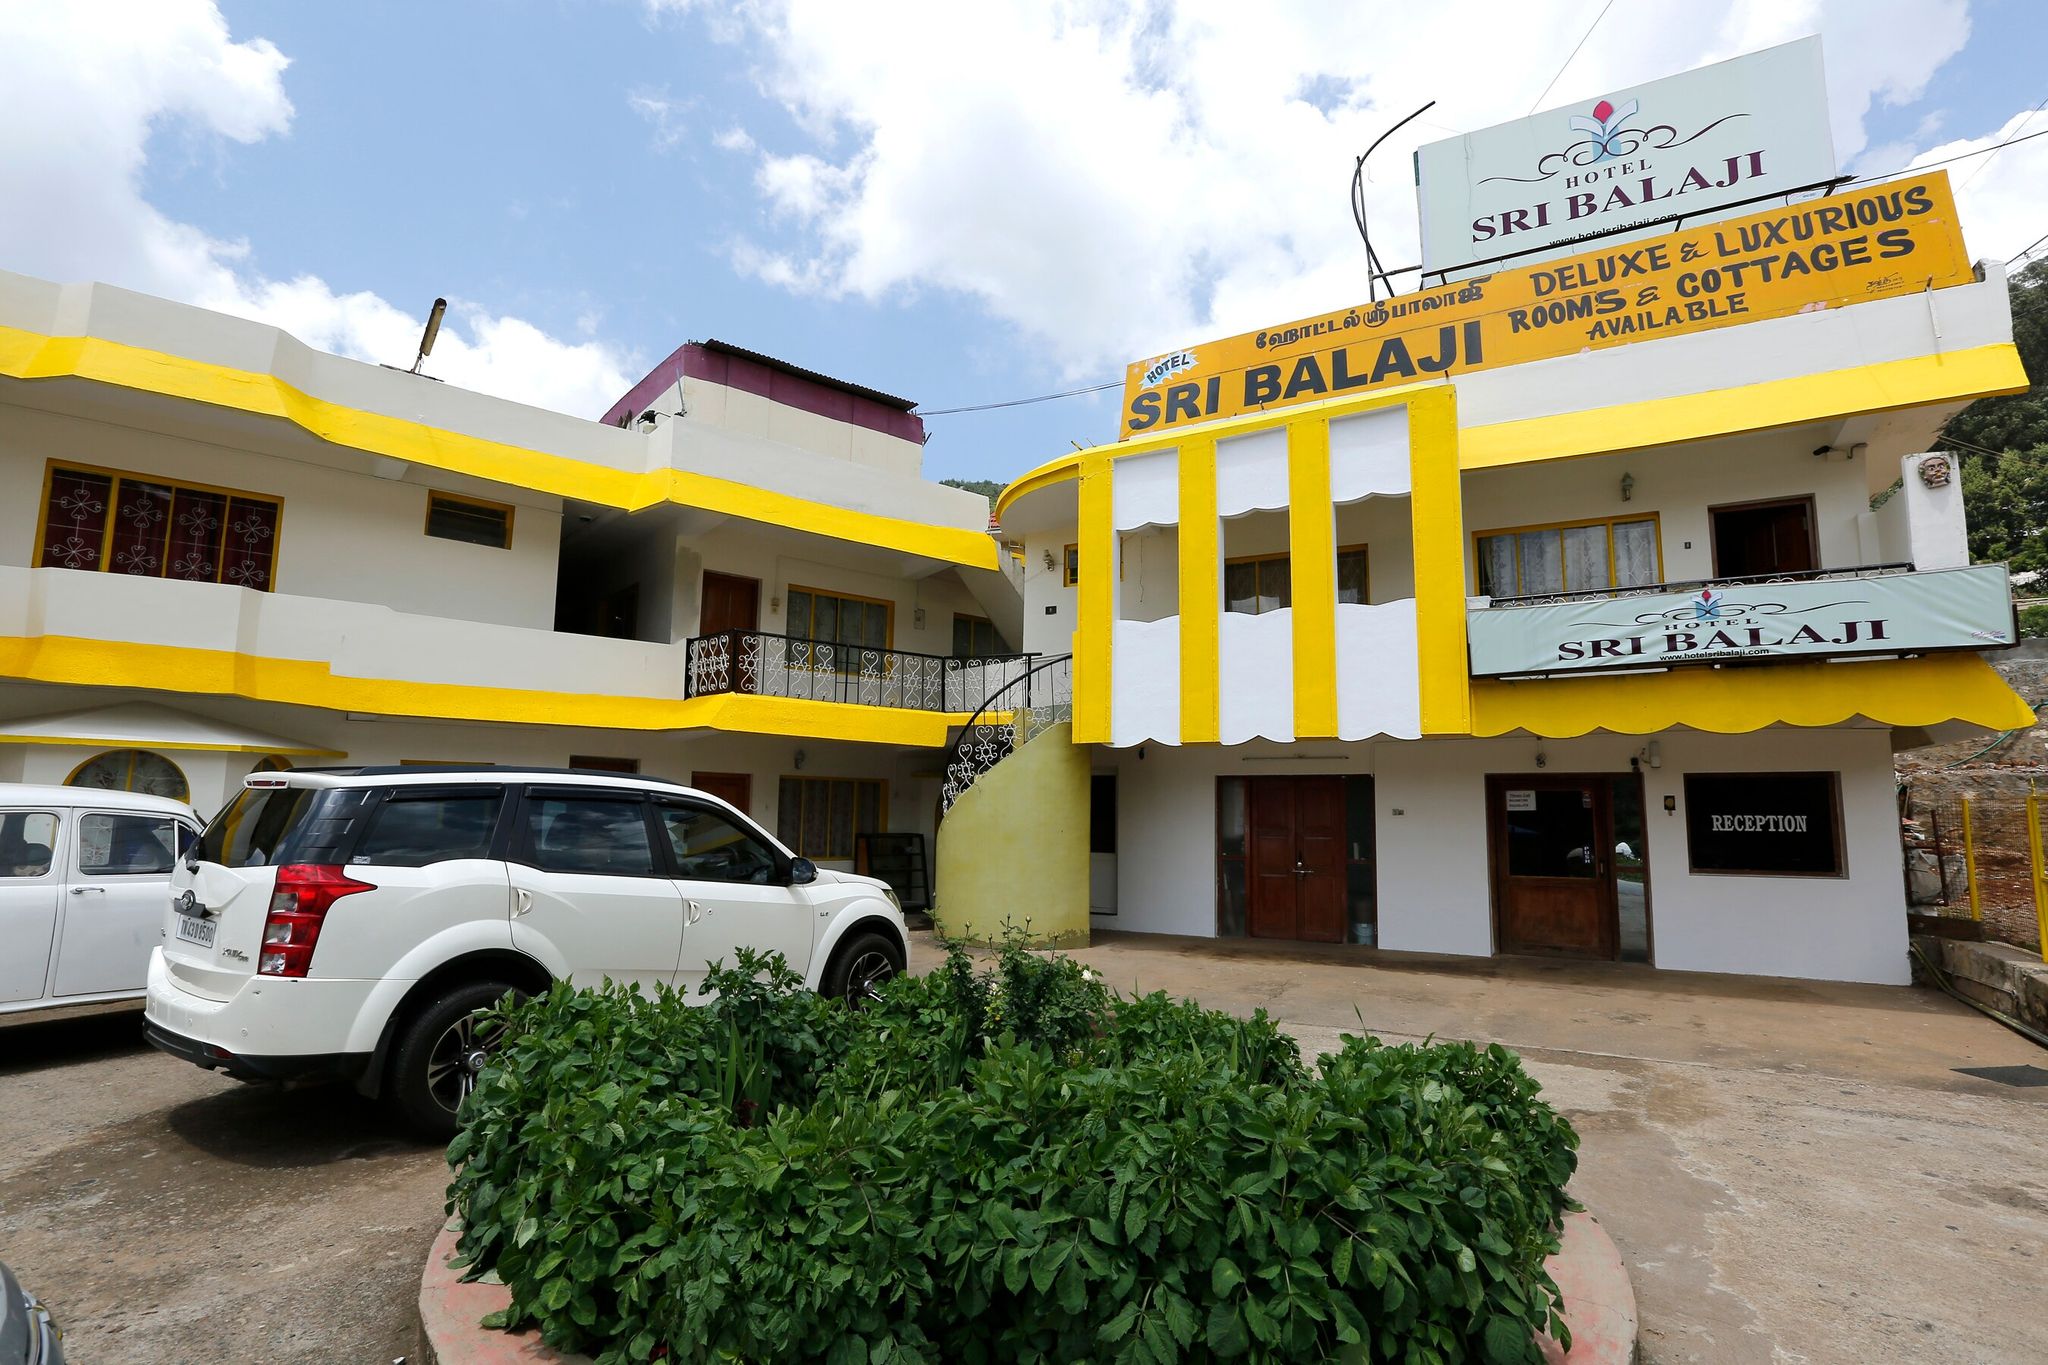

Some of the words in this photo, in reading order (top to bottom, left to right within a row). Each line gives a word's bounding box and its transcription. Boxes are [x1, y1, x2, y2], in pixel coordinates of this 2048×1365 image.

[1566, 159, 1652, 189] HOTEL
[1472, 200, 1551, 243] SRI
[1568, 150, 1766, 221] BALAJI
[1530, 243, 1671, 297] DELUXE
[1681, 236, 1710, 262] &
[1714, 185, 1934, 258] LUXURIOUS
[1508, 288, 1628, 334] ROOMS
[1635, 285, 1662, 307] &
[1676, 228, 1916, 298] COTTAGES
[1256, 310, 1361, 352] ஹோட்டல்
[1585, 292, 1750, 341] AVAILABLE
[1127, 376, 1221, 430] SRI
[1243, 320, 1484, 407] BALAJI
[1146, 353, 1190, 384] HOTEL
[1558, 636, 1646, 662] SRI
[1662, 619, 1891, 653] BALAJI
[1663, 617, 1759, 631] HOTEL
[1660, 648, 1770, 661] www.hotelsribalaji.com
[1711, 815, 1807, 832] RECEPTION
